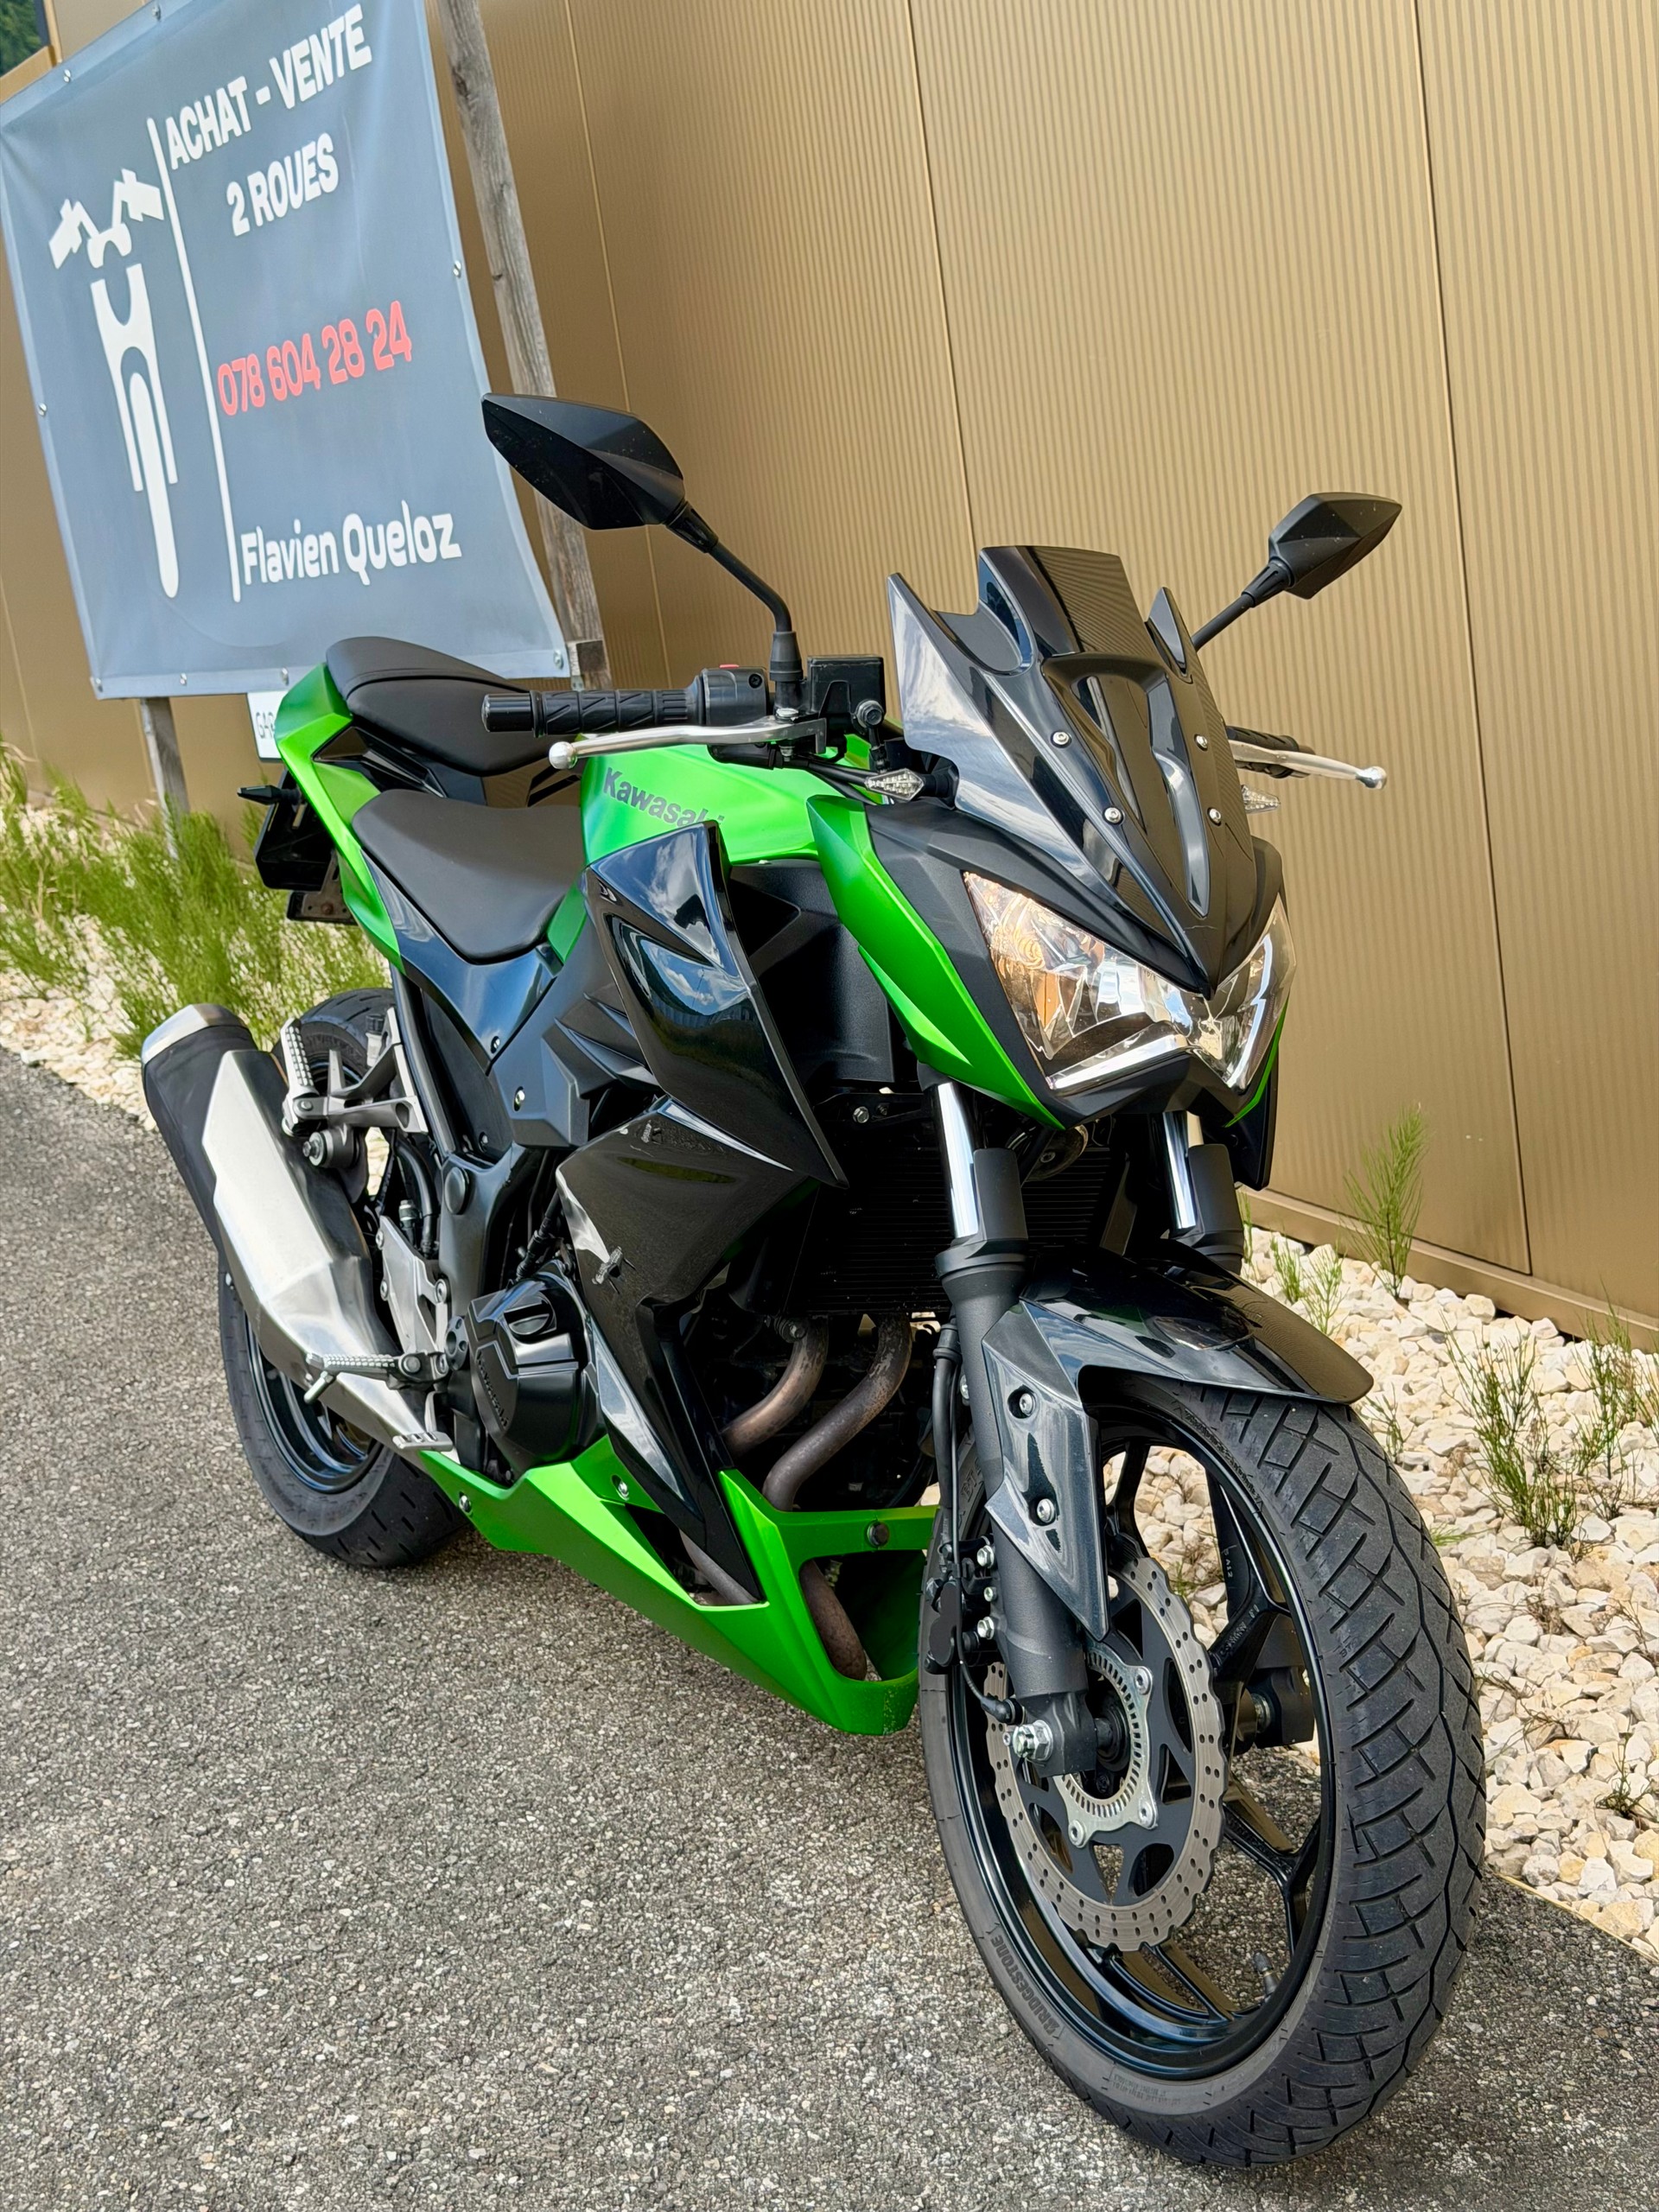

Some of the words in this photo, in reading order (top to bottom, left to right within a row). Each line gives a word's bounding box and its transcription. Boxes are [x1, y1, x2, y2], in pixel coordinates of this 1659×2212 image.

[166, 76, 251, 170] ACHAT
[256, 86, 271, 105] -
[269, 3, 372, 109] VENTE
[226, 181, 251, 237] 2
[247, 133, 339, 226] ROUES
[218, 353, 265, 416] 078
[267, 334, 321, 401] 604
[321, 318, 365, 385] 28
[365, 300, 412, 371] 24
[240, 518, 340, 585] Flavien
[342, 499, 462, 586] Queloz
[603, 767, 724, 827] Kawasa
[990, 1935, 1060, 2036] BRIDGESTONE
